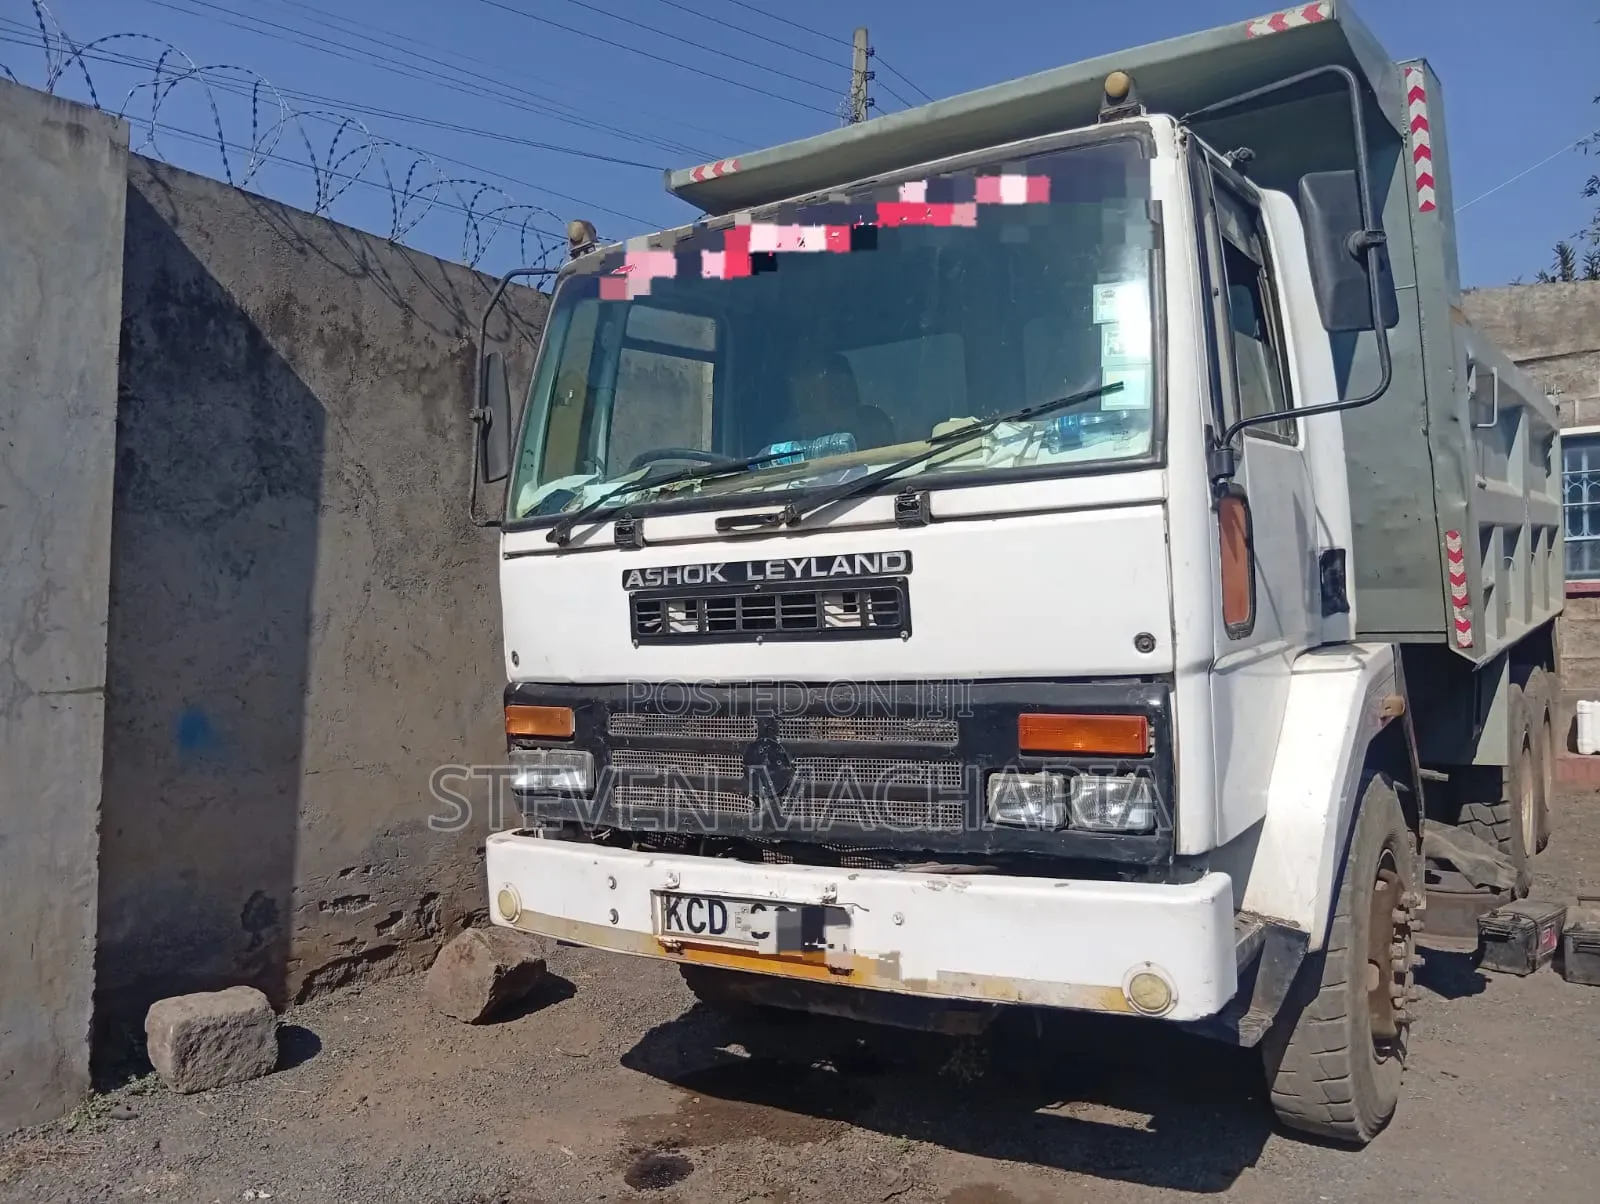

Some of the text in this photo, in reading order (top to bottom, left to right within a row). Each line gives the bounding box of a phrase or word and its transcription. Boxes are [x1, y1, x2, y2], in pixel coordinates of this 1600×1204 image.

[625, 550, 908, 588] ASHOK LEYLAND
[665, 896, 728, 935] KCD
